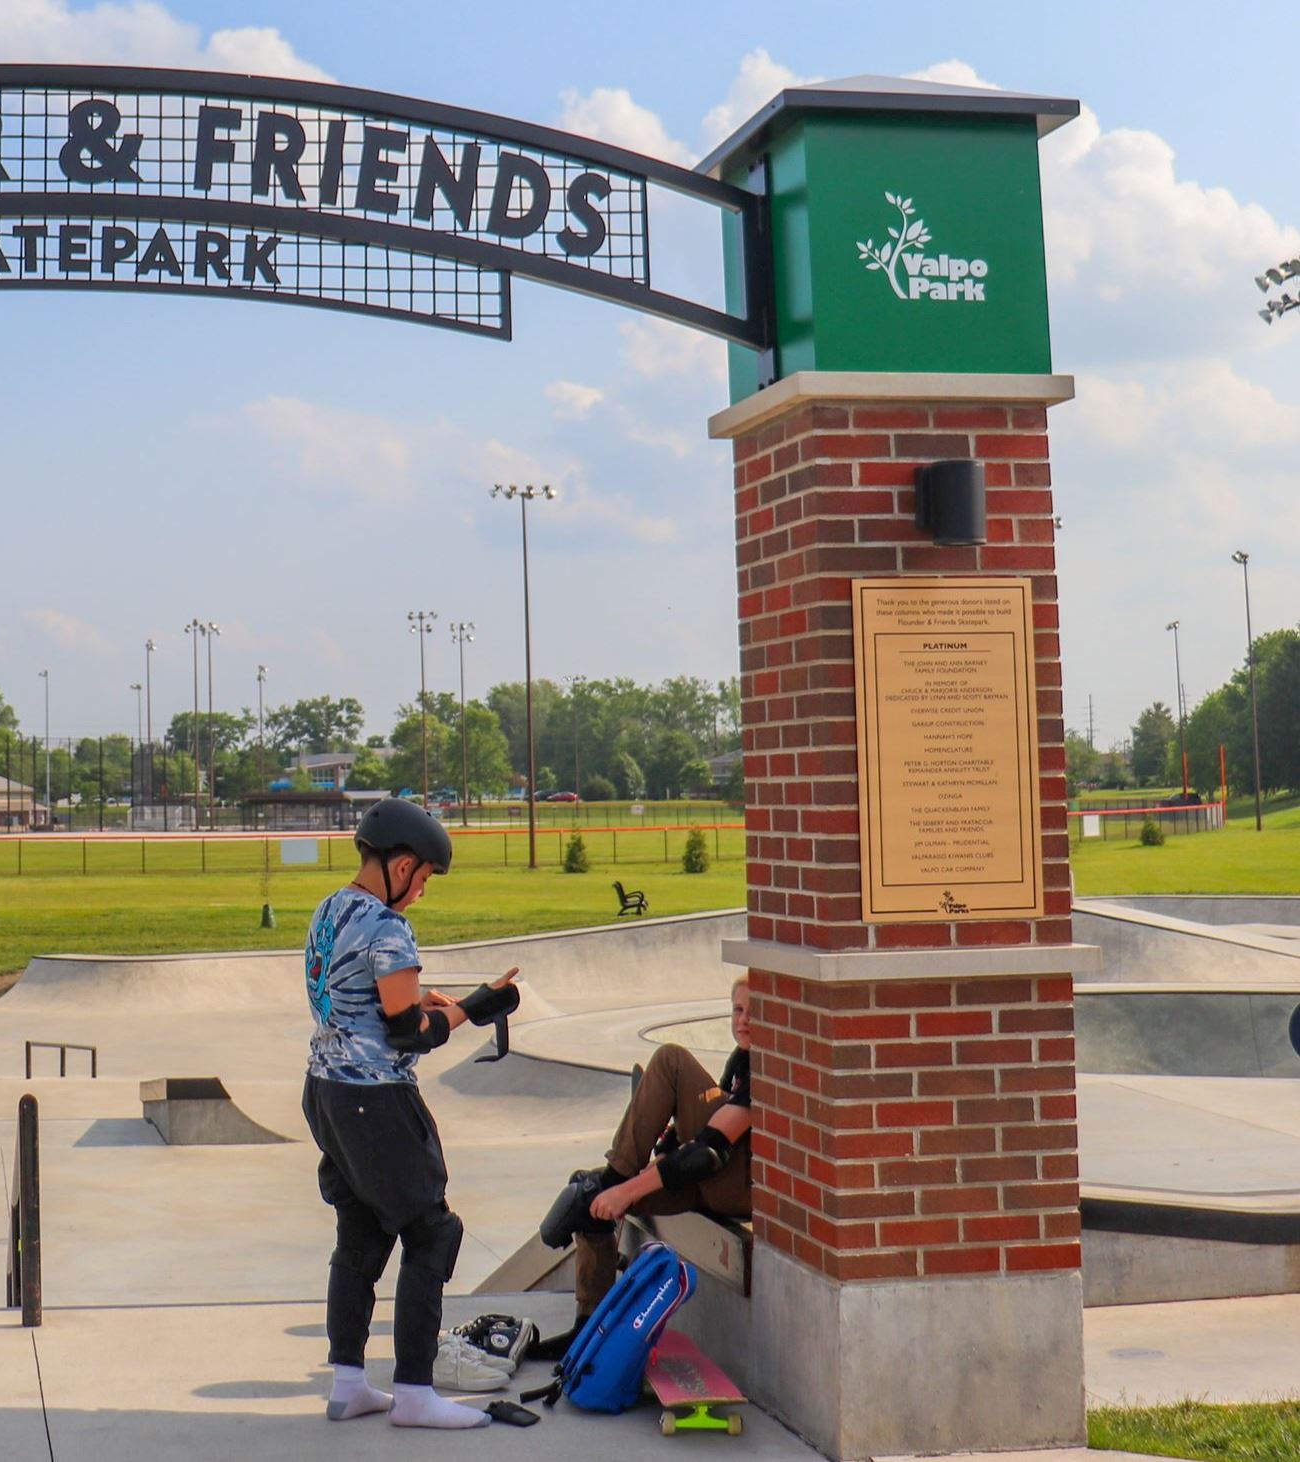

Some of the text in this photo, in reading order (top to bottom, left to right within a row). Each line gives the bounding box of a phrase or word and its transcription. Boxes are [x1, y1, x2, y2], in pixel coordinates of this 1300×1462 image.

[58, 98, 144, 185] &
[193, 104, 612, 258] FRIENDS
[901, 253, 988, 281] Valpo
[908, 277, 985, 301] Park
[633, 1276, 673, 1328] Champion
